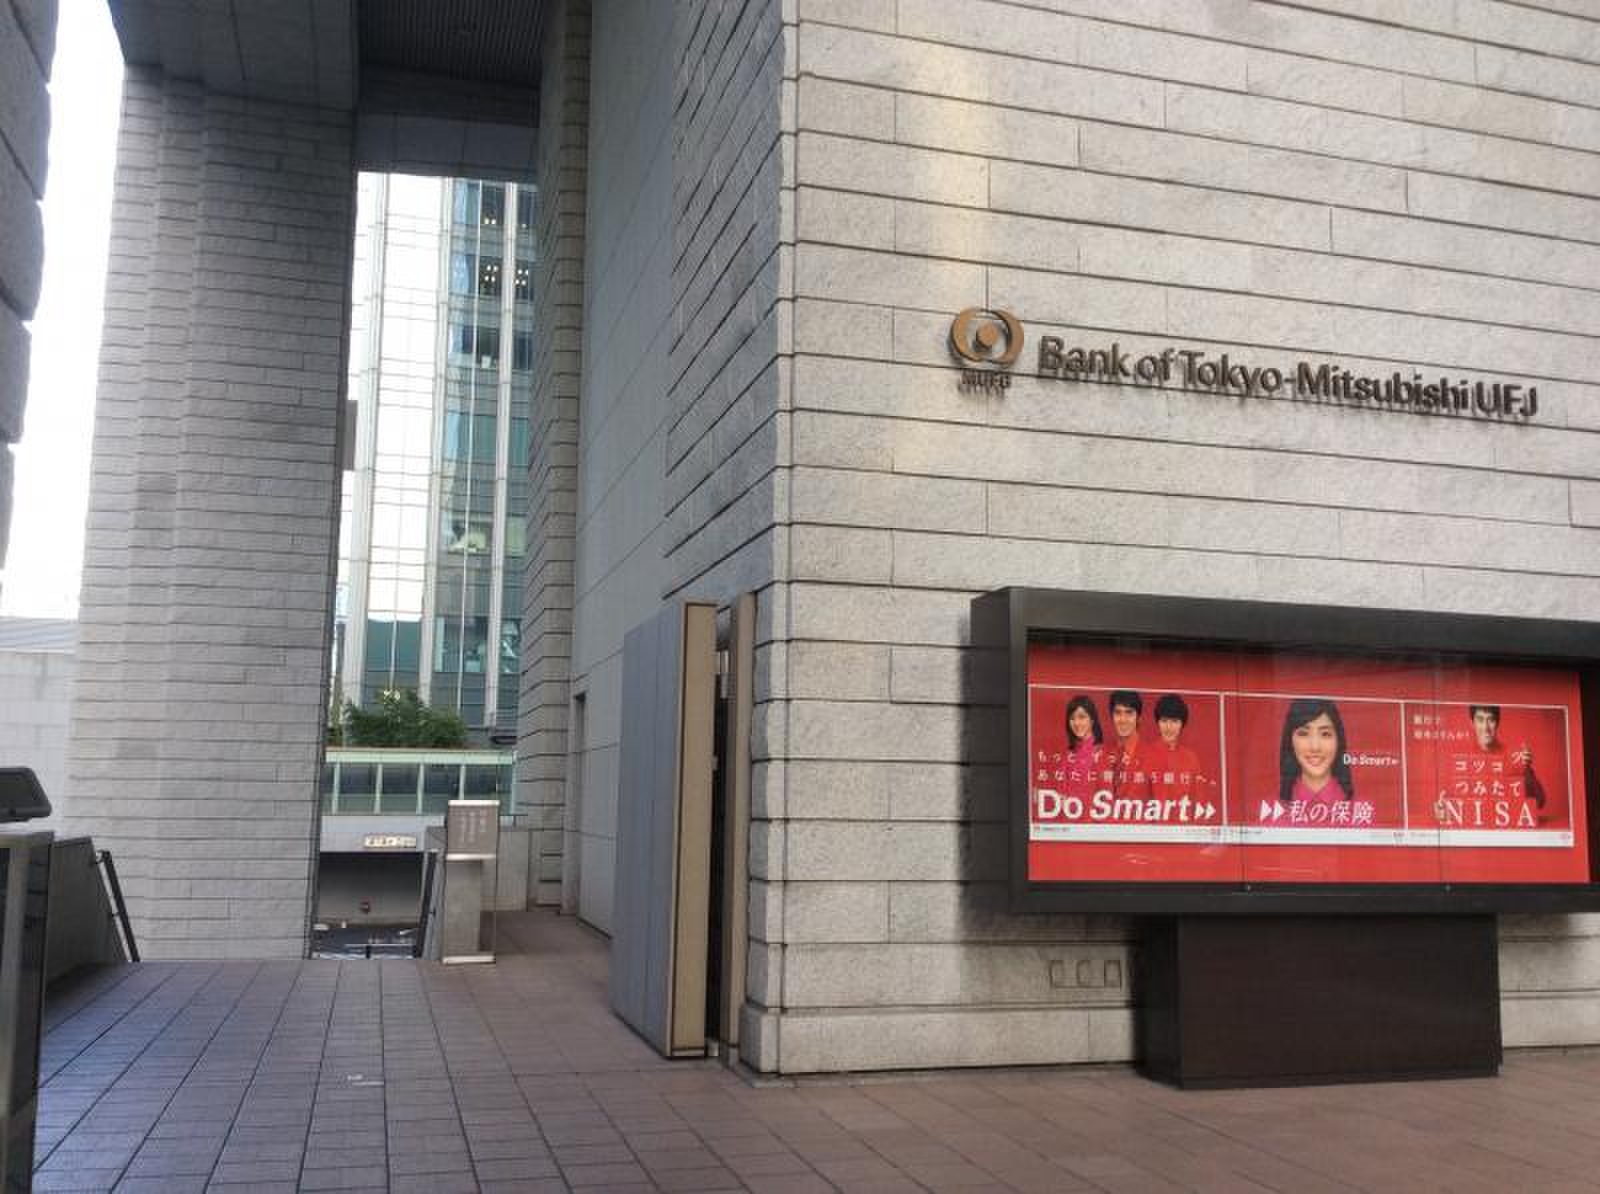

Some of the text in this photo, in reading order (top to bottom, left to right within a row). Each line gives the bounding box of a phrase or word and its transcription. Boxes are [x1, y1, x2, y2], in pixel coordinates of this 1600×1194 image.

[1038, 335, 1538, 417] Bank of Tokyo-Mitsubishi UFJ
[1344, 753, 1358, 765] Do
[1455, 780, 1521, 797] つみたて
[1037, 790, 1193, 821] Do Smart
[1289, 799, 1376, 824] 私の保険
[1443, 801, 1537, 827] NISA
